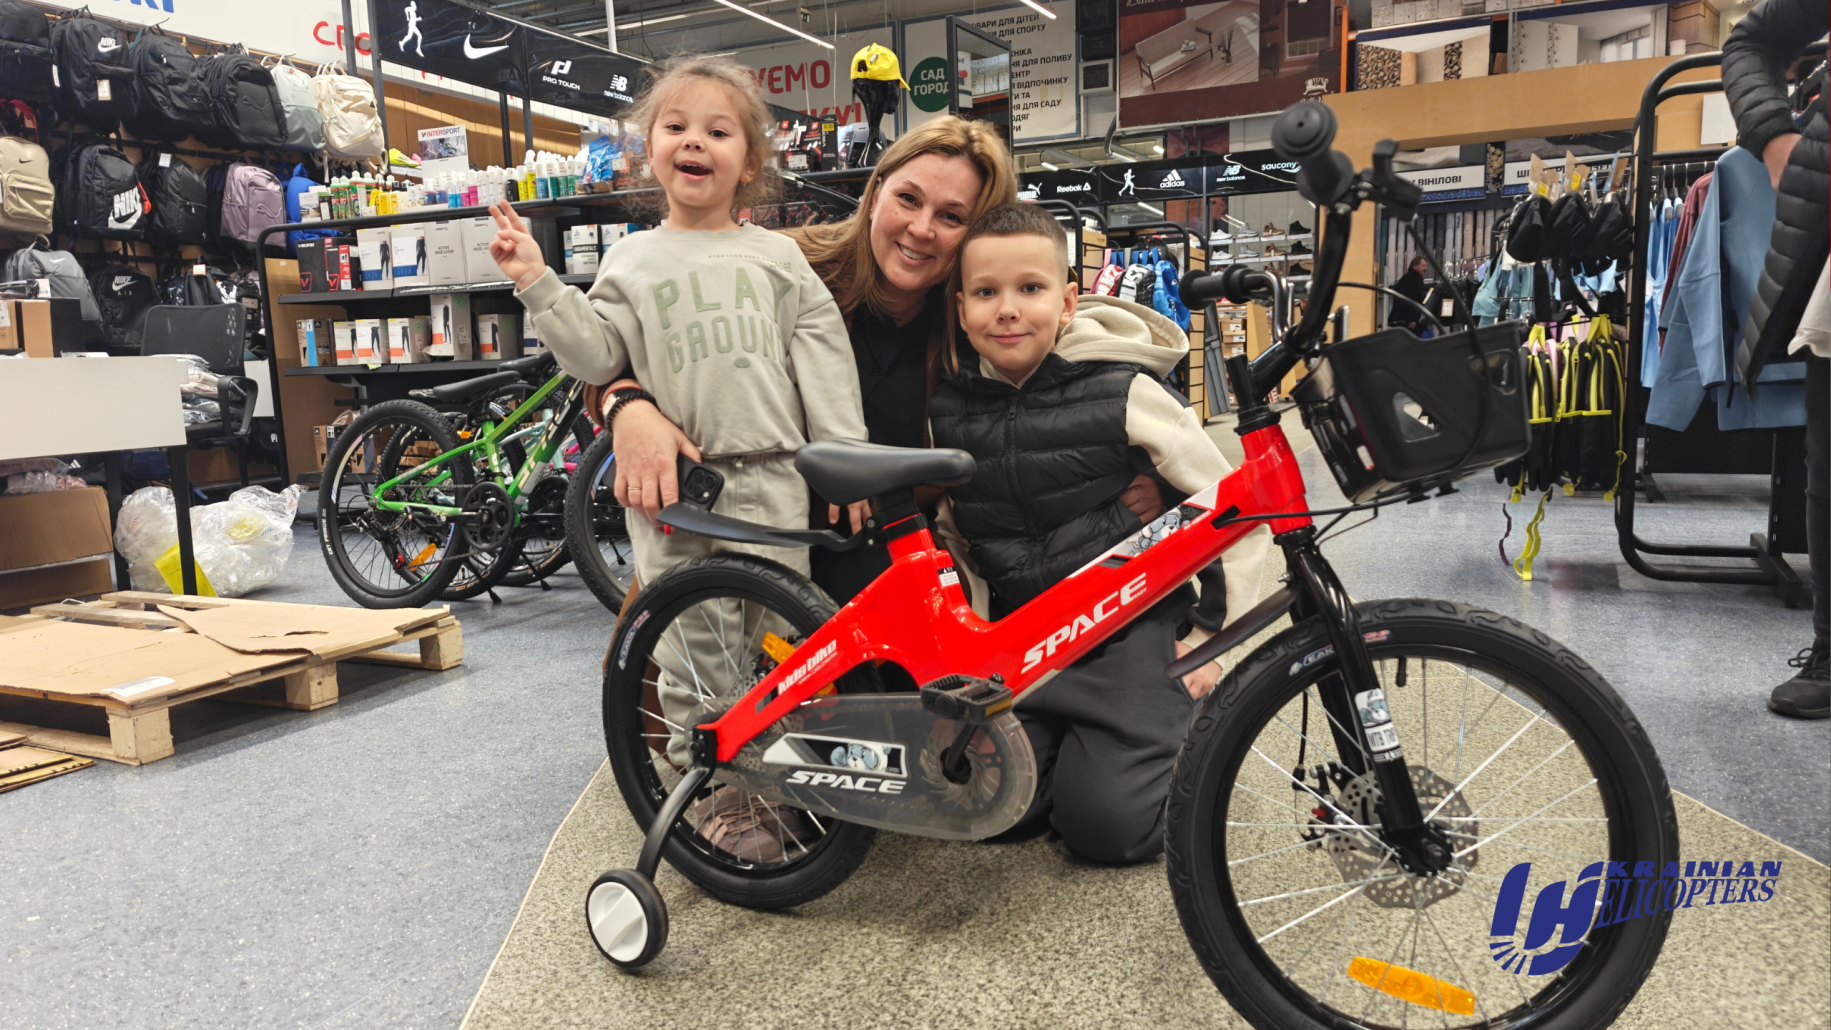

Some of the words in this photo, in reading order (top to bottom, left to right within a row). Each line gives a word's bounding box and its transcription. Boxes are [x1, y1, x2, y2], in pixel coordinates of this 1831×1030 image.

[998, 17, 1015, 27] ДЛЯ
[1016, 13, 1039, 24] ДІТЕЙ
[998, 29, 1015, 37] ДЛЯ
[1016, 23, 1046, 35] СПОРТУ
[100, 37, 117, 47] NIKE
[1022, 58, 1039, 68] ДЛЯ
[1040, 53, 1072, 64] ПОЛИВУ
[920, 67, 945, 81] САД
[1012, 70, 1030, 79] ЕНТР
[542, 75, 557, 85] PRO
[558, 78, 581, 91] TOUCH
[604, 90, 614, 98] new
[1022, 101, 1039, 110] ДЛЯ
[1040, 99, 1061, 108] САДУ
[426, 126, 461, 138] INTERSPORT
[1261, 160, 1297, 171] saucony
[1159, 179, 1185, 189] adidas
[1417, 175, 1462, 186] ВІНІЛОВІ
[1056, 184, 1083, 194] Reebok
[113, 186, 142, 218] NIKE
[114, 275, 133, 287] NIKE
[652, 267, 795, 331] PLAY
[1021, 571, 1147, 675] SPACE
[778, 662, 808, 695] kids
[806, 639, 837, 674] bike
[786, 770, 907, 795] SPACE
